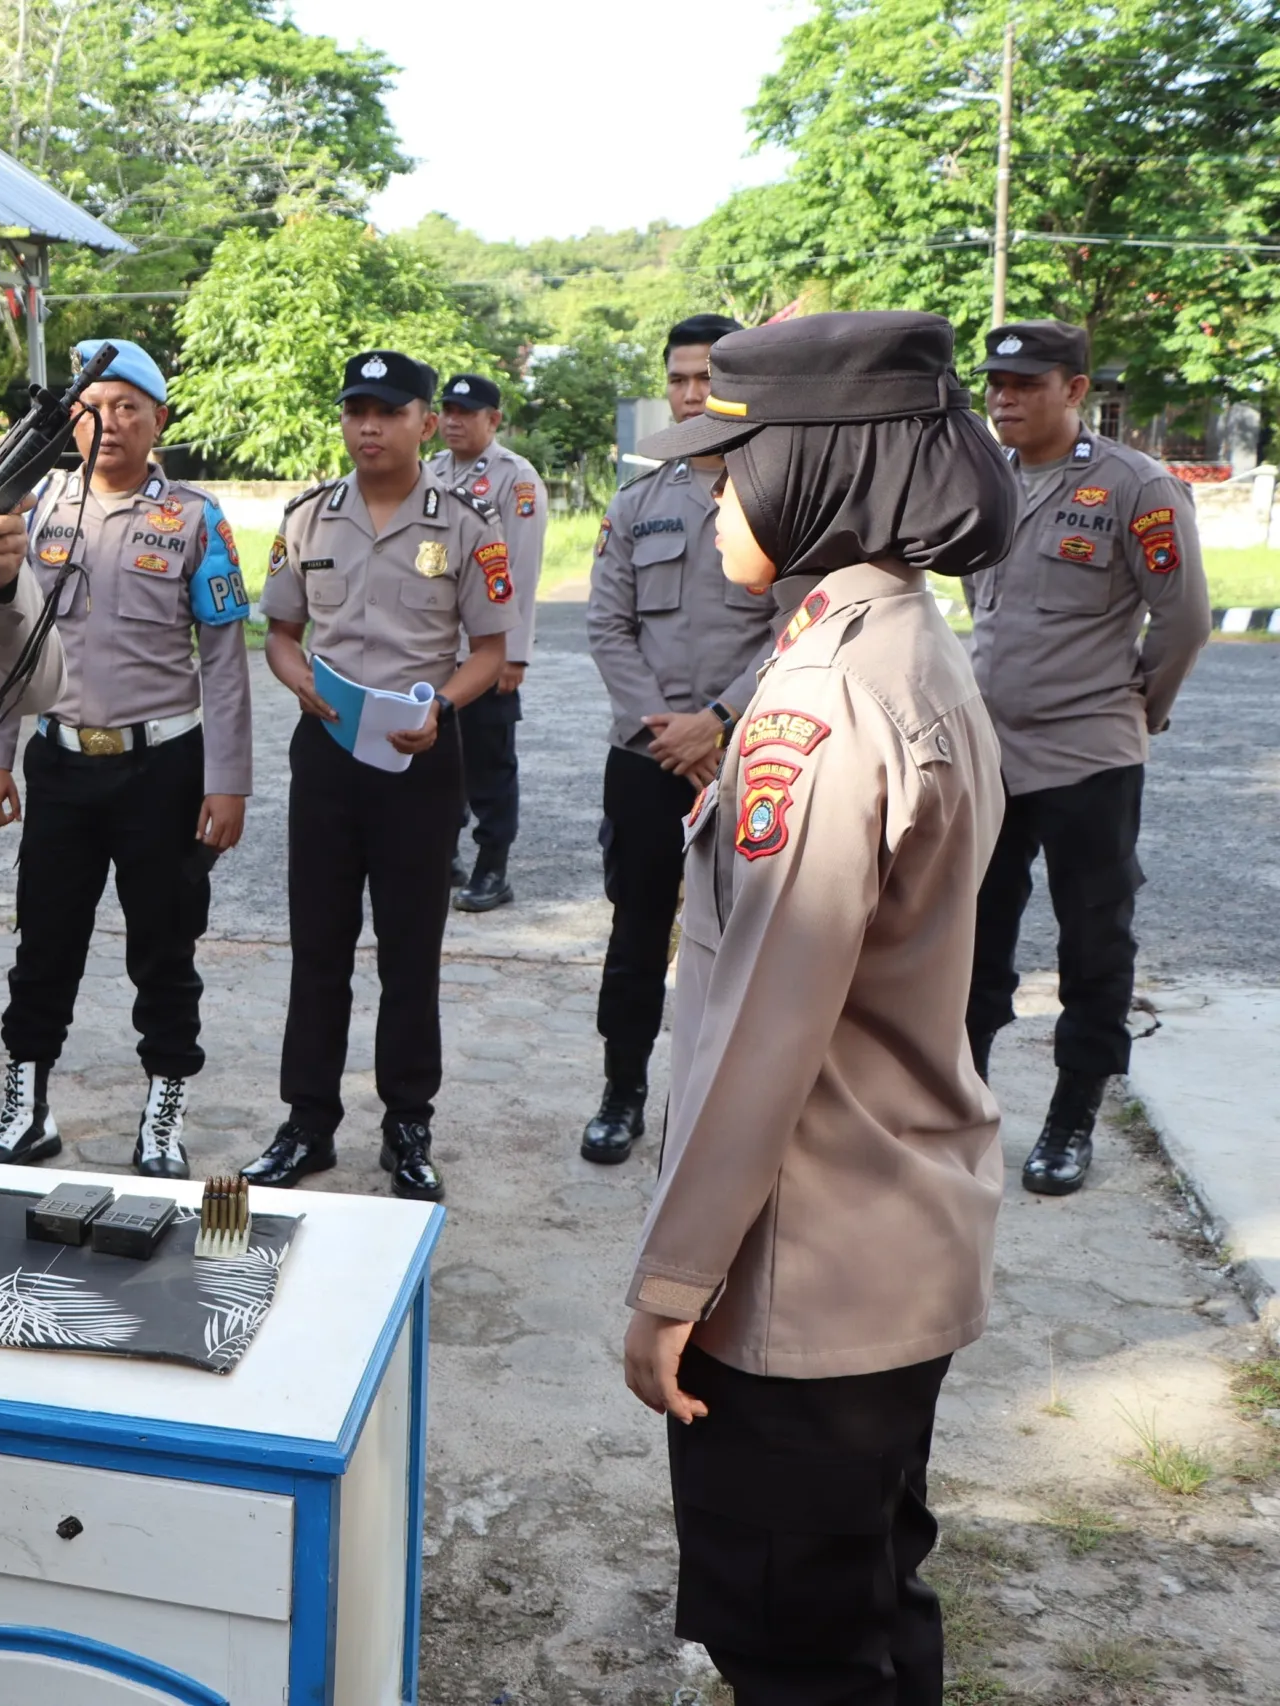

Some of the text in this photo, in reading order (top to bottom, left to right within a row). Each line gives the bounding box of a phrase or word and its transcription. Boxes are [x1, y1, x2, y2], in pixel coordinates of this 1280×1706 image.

[632, 517, 684, 538] CANDRA
[1055, 511, 1113, 532] POLRI
[132, 532, 186, 553] POLRI
[746, 714, 817, 738] POLRES
